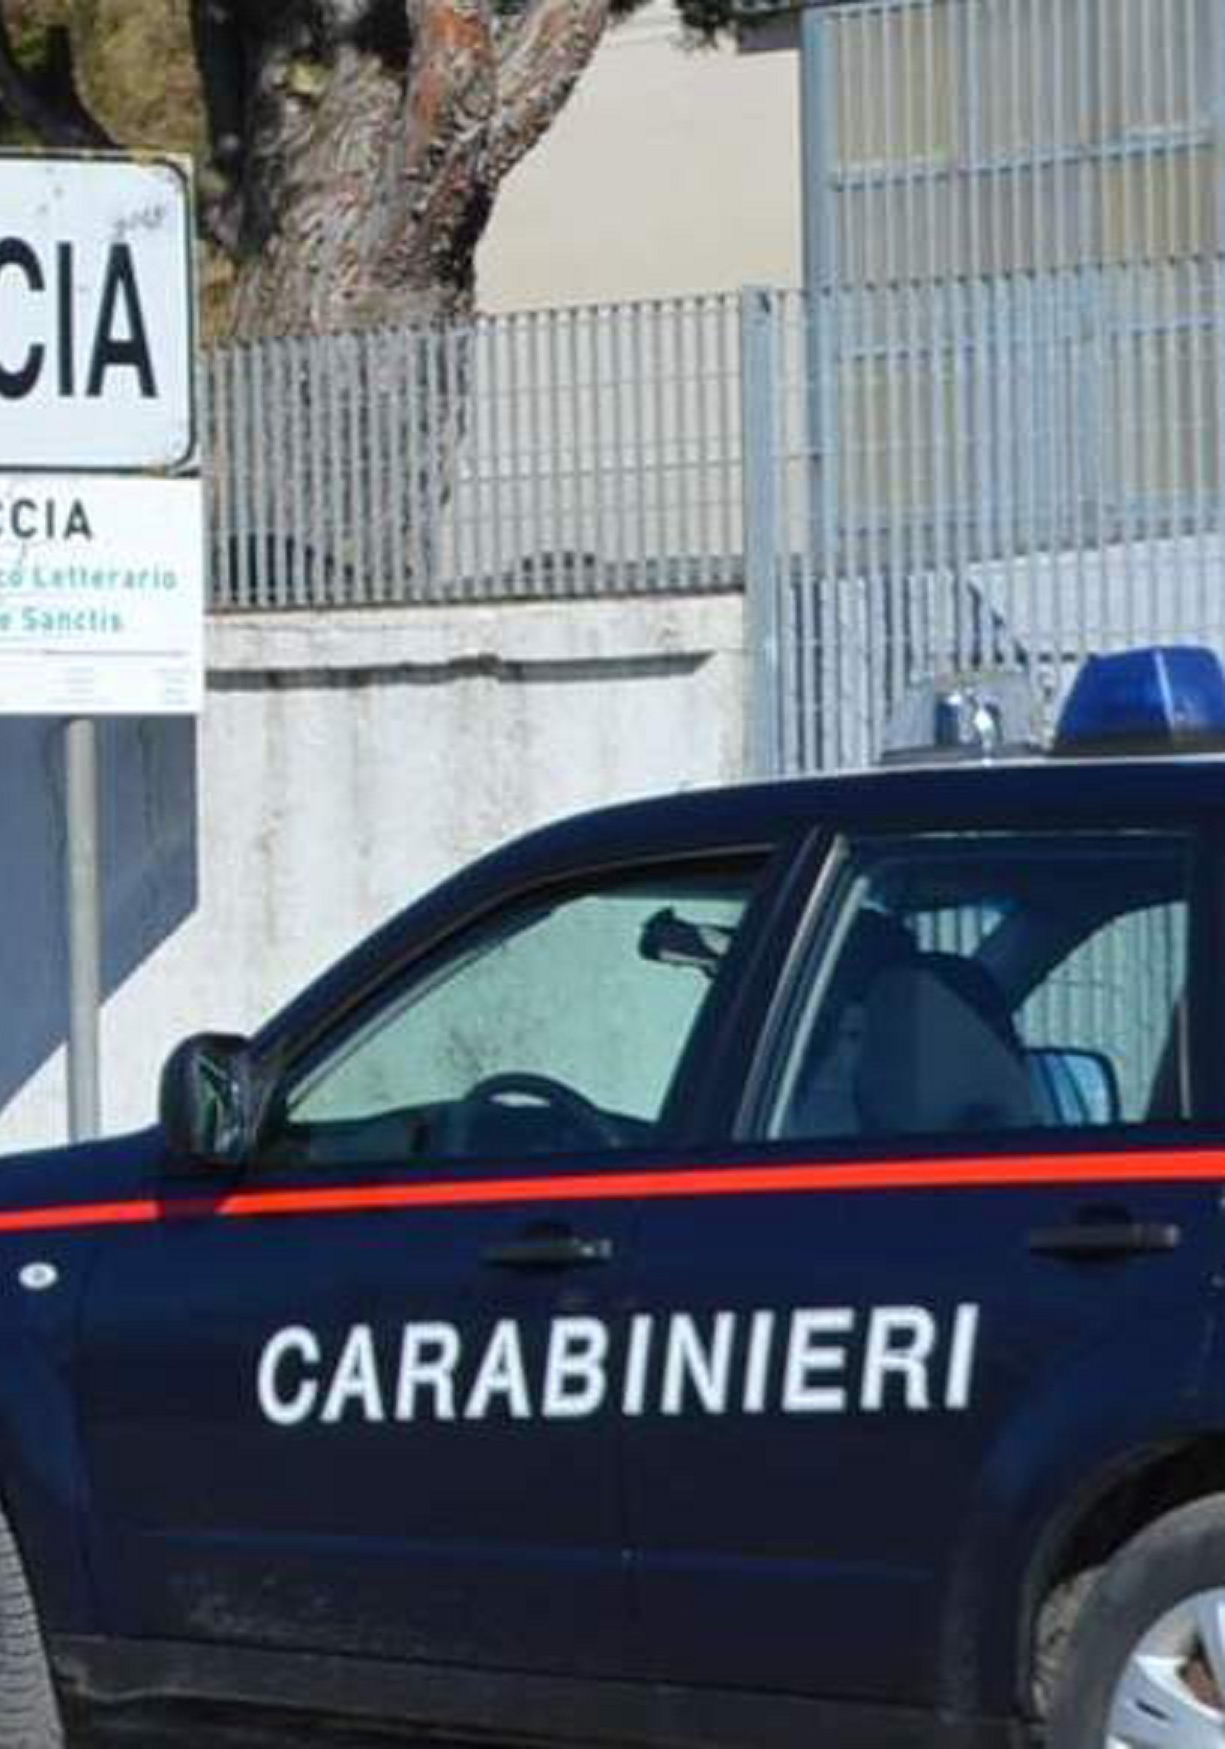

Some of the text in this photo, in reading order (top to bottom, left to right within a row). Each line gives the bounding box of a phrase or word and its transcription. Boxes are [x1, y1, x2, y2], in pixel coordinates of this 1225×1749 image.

[33, 565, 177, 590] Letterario
[21, 606, 124, 633] Sanctis
[257, 1303, 979, 1424] CARABINIERI
